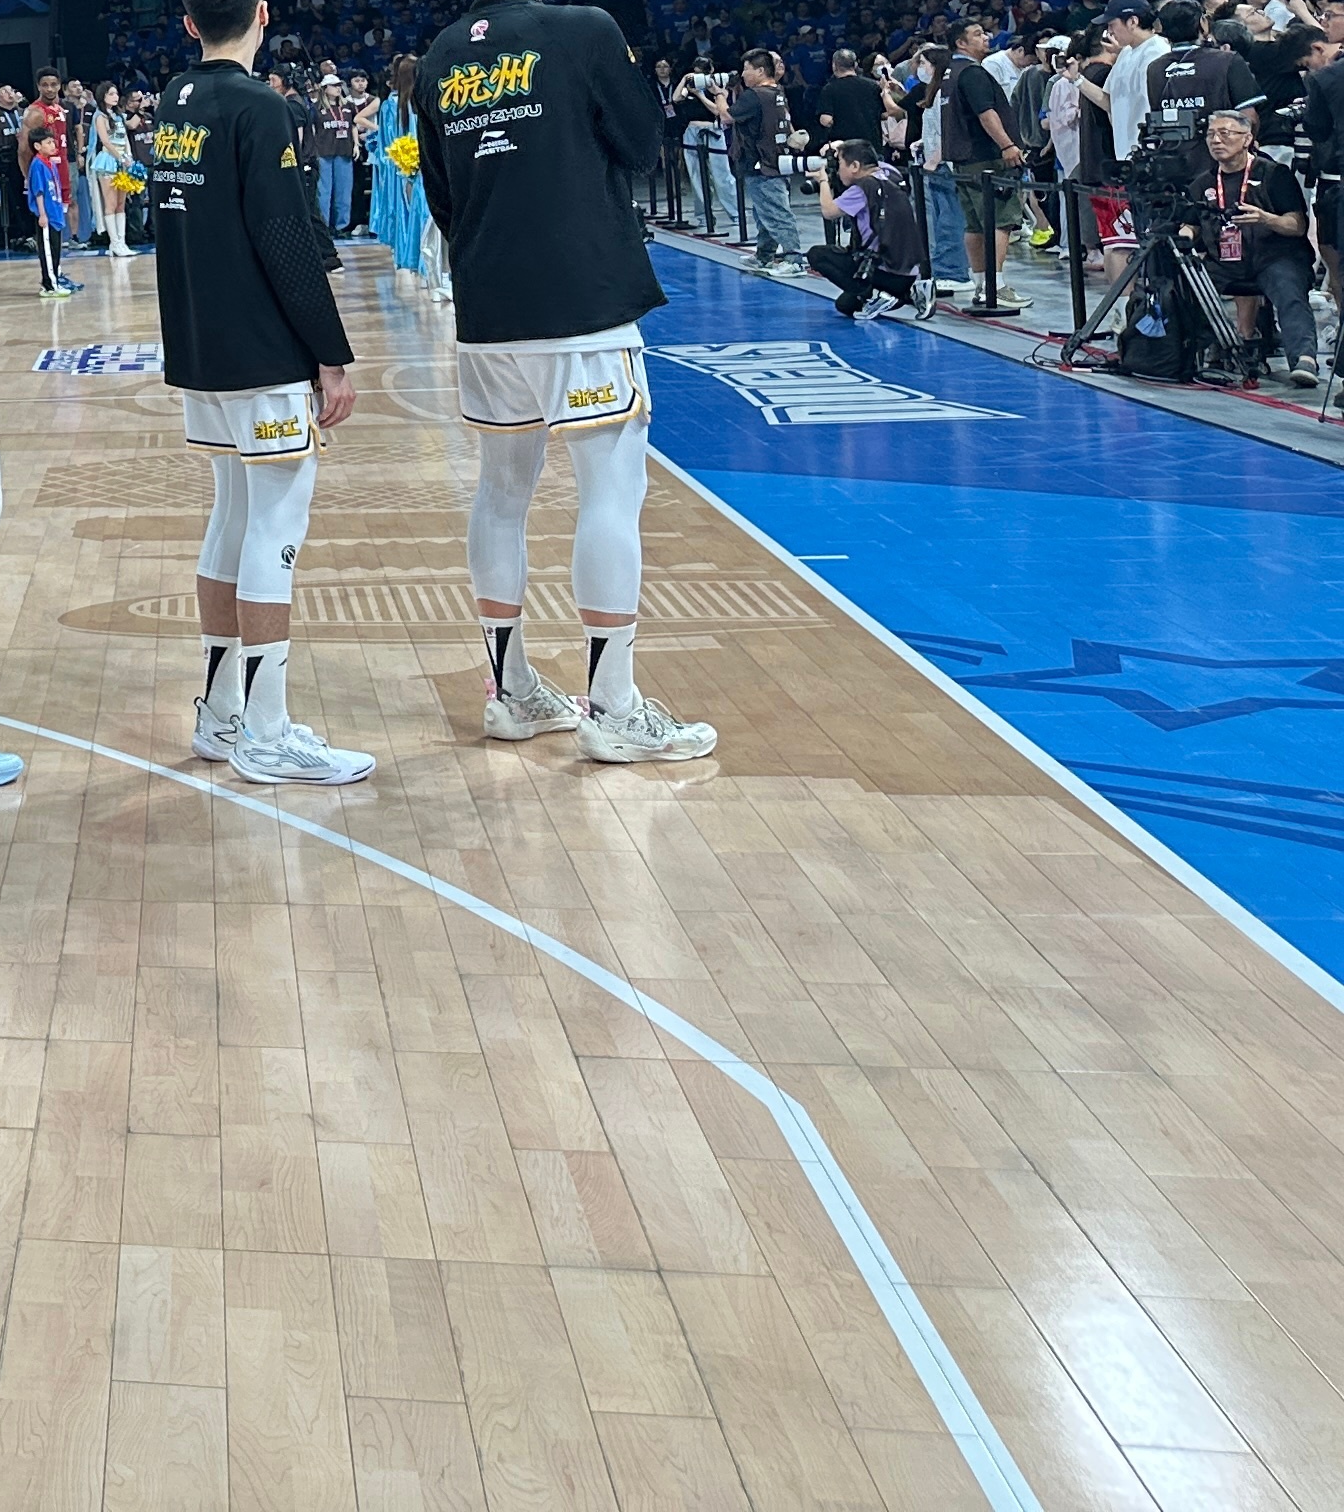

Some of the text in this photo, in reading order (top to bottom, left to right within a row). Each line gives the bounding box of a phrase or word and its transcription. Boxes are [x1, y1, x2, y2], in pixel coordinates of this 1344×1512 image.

[438, 50, 541, 116] 杭州
[490, 103, 542, 125] ZHOU
[568, 382, 618, 409] 浙江
[641, 340, 1026, 426] DUCKS
[253, 415, 303, 440] 浙江
